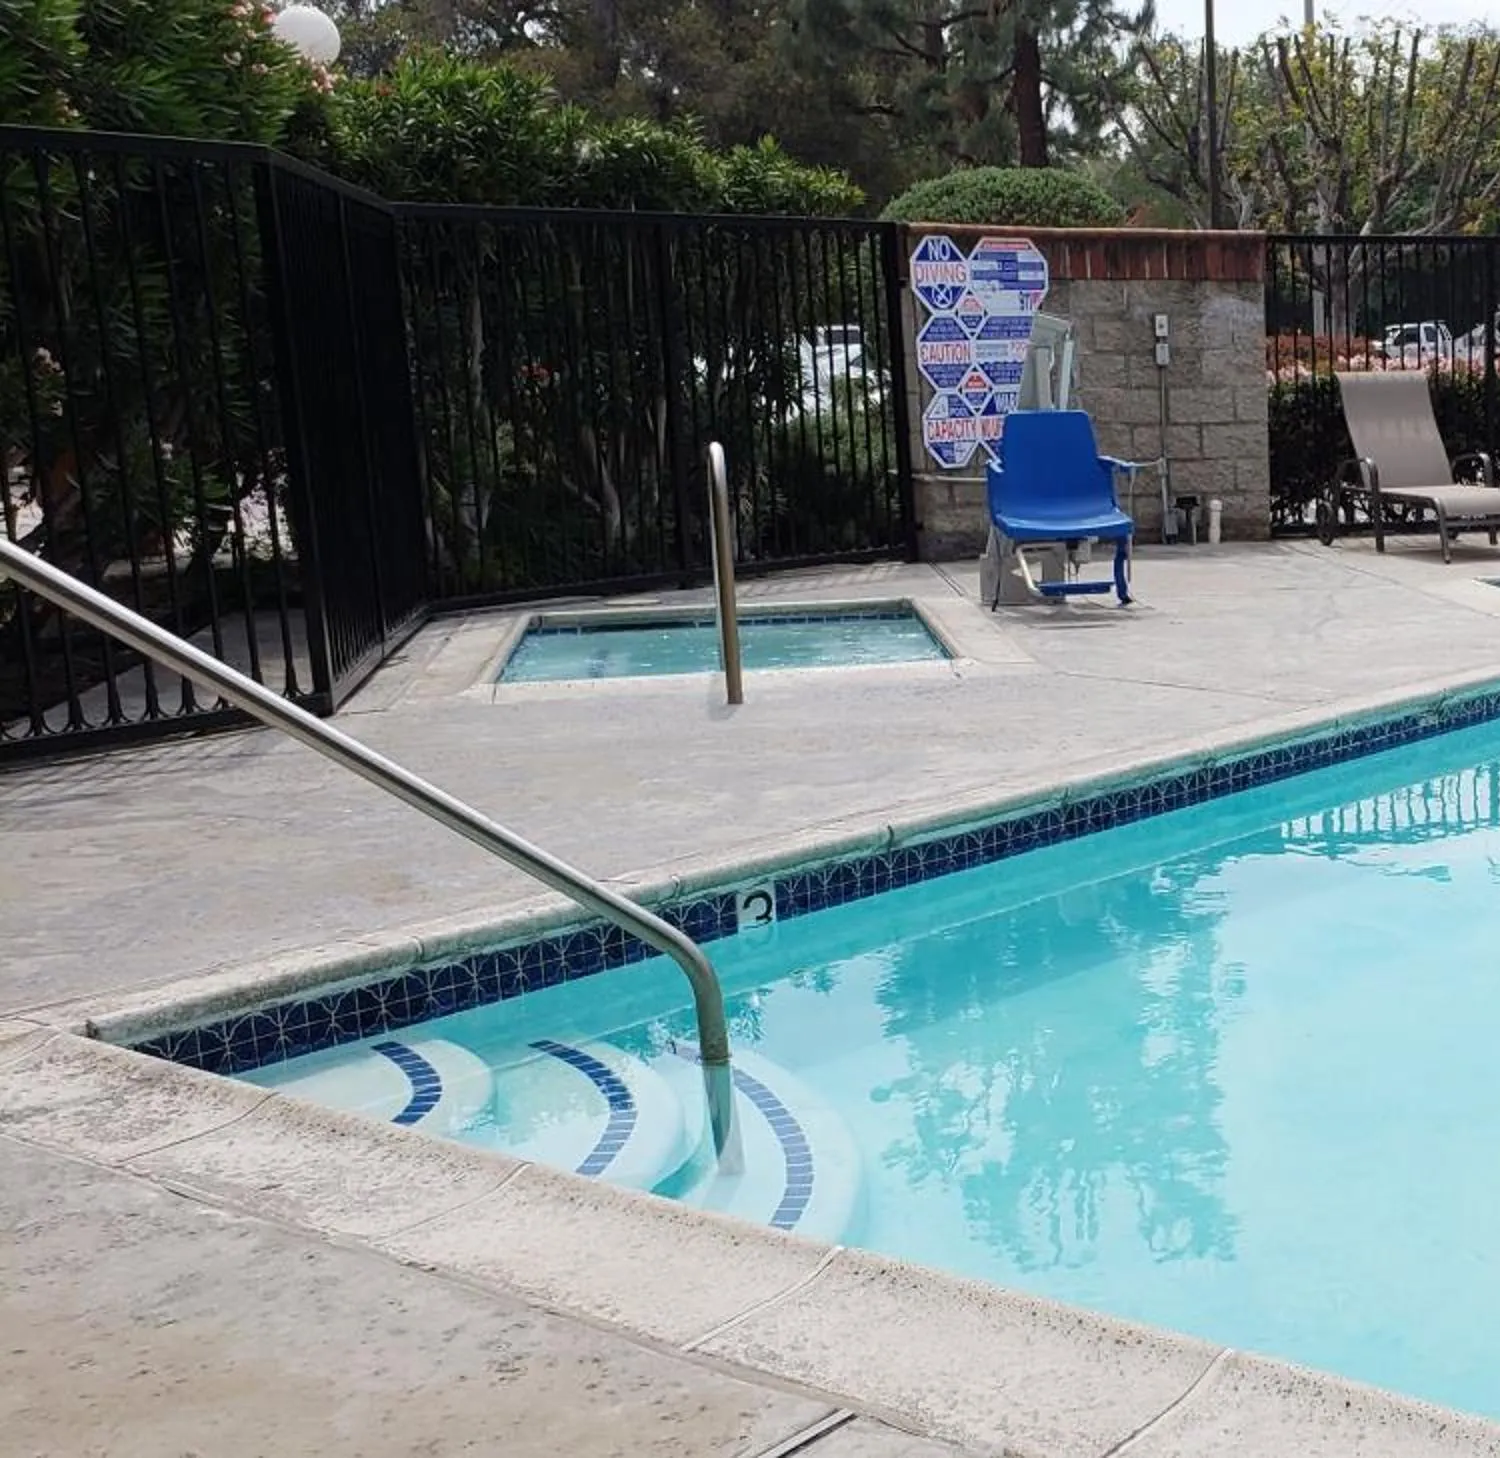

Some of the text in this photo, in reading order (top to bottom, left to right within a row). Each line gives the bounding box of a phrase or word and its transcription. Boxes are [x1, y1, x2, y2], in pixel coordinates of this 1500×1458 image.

[927, 238, 951, 261] NO
[915, 262, 967, 283] DIVING
[920, 342, 971, 363] CAUTION
[927, 420, 977, 440] CAPACITY
